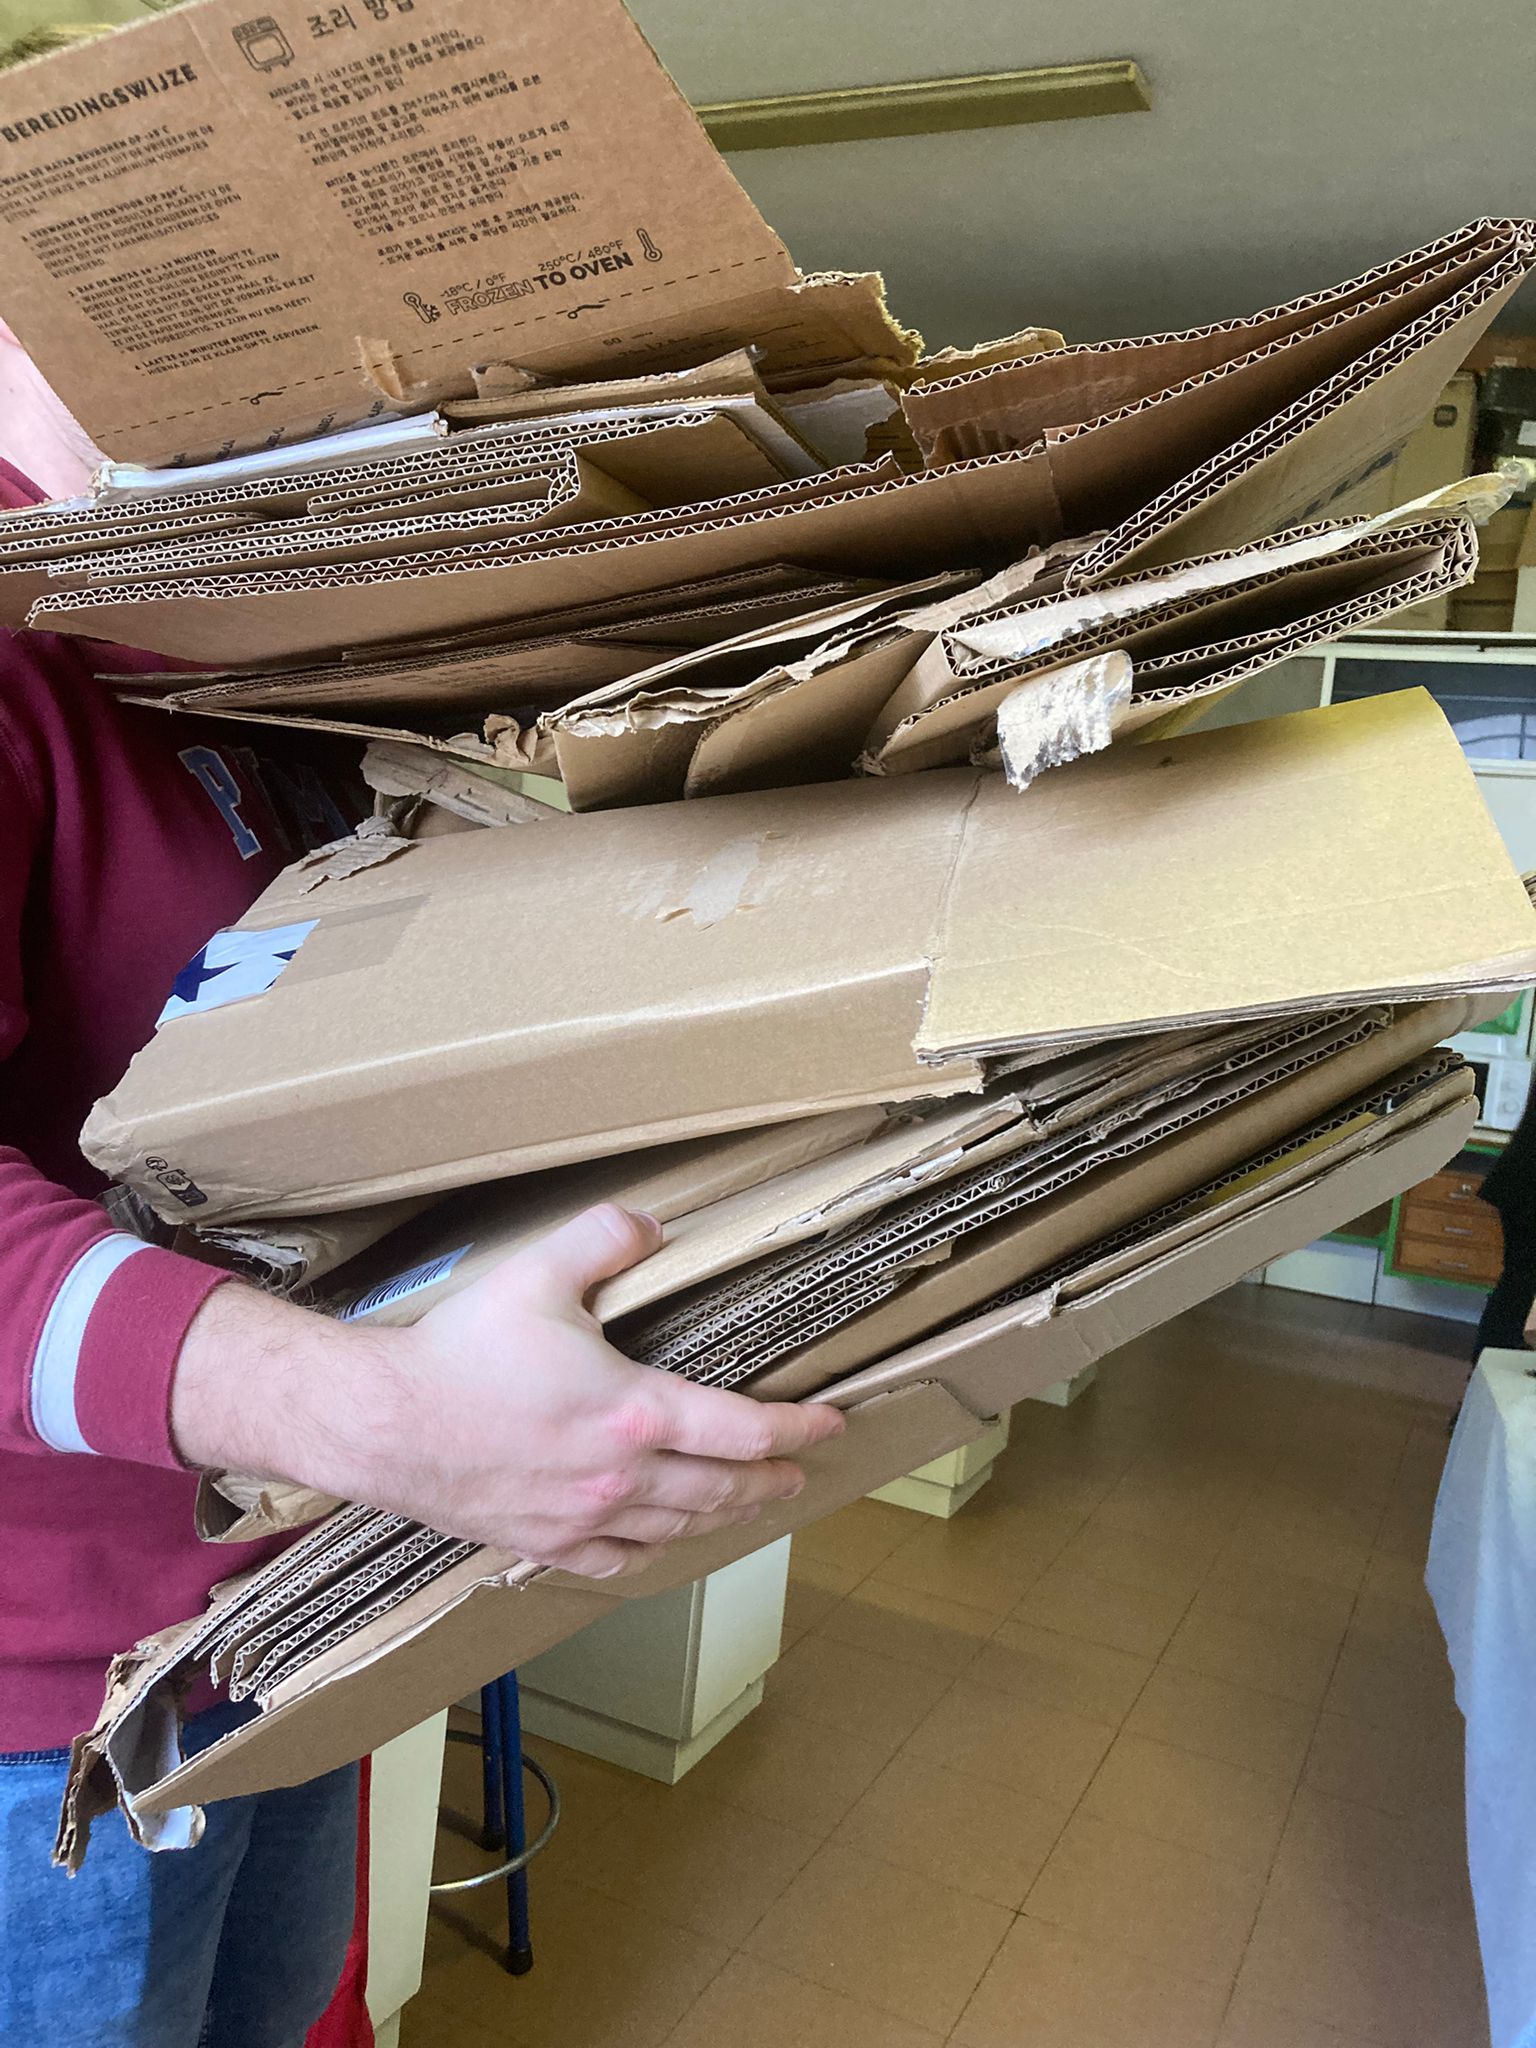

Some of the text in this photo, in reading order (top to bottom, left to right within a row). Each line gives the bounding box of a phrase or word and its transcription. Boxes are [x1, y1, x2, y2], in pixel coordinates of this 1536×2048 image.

[307, 4, 357, 39] 조리
[0, 64, 199, 142] BEREIDINGSWIJZE
[172, 248, 216, 265] MINUTEN
[483, 272, 509, 286] 0°F
[584, 240, 627, 259] 480°F
[189, 280, 220, 293] KLAAR
[194, 291, 221, 302] OVEN
[234, 284, 282, 301] VORMPJES
[297, 274, 316, 284] ZET
[442, 251, 634, 315] FROZEN TO OVEN
[263, 304, 283, 314] ERG
[148, 320, 192, 336] PAPIEREN
[141, 357, 164, 367] LAAT
[189, 339, 231, 354] MINUTEN
[230, 329, 267, 343] RUSTEN
[146, 362, 180, 375] HIERNA
[179, 357, 200, 366] ZIJN
[212, 345, 243, 357] KLAAR
